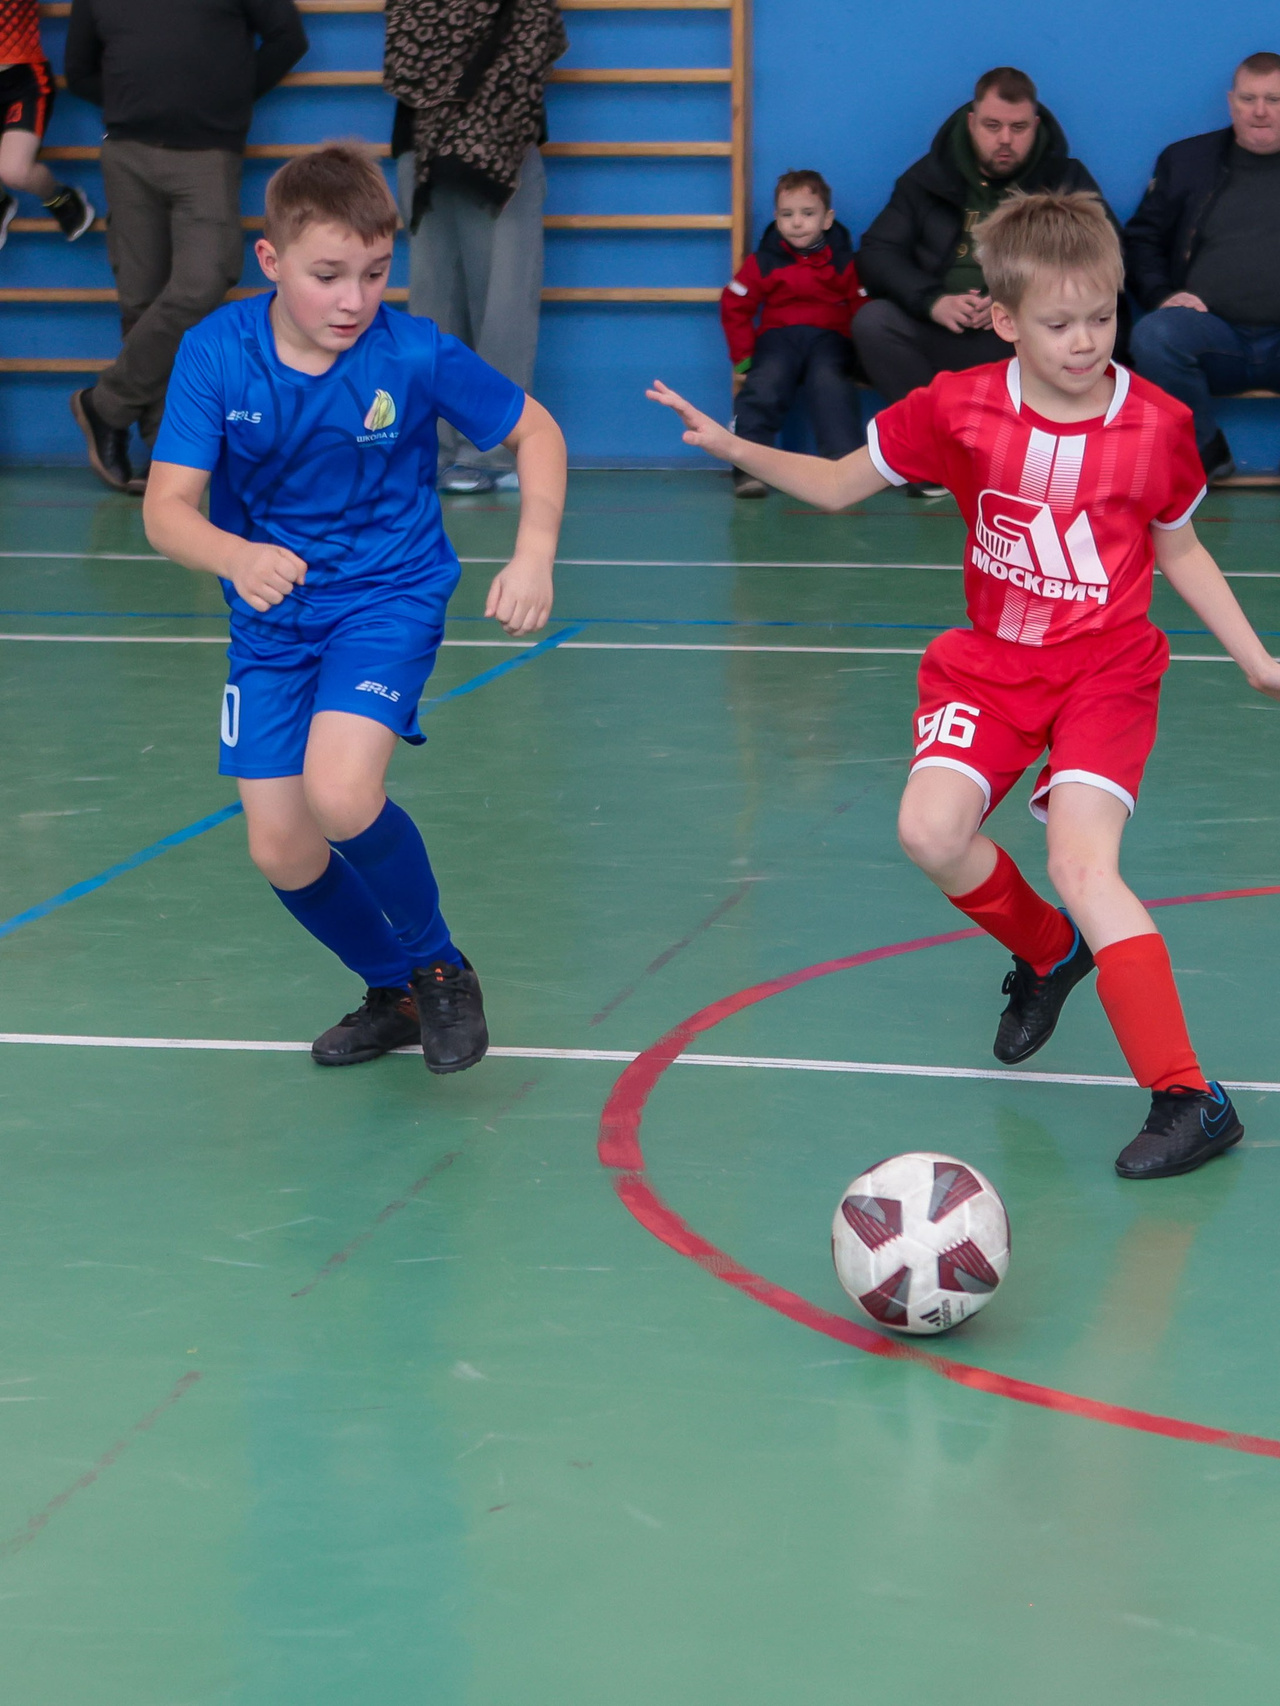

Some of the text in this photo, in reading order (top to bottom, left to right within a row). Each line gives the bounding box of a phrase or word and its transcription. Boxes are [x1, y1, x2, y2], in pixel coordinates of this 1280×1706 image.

[356, 432, 388, 443] ШКОЛА
[971, 545, 1109, 605] МОСКВИЧ
[915, 701, 981, 757] 96
